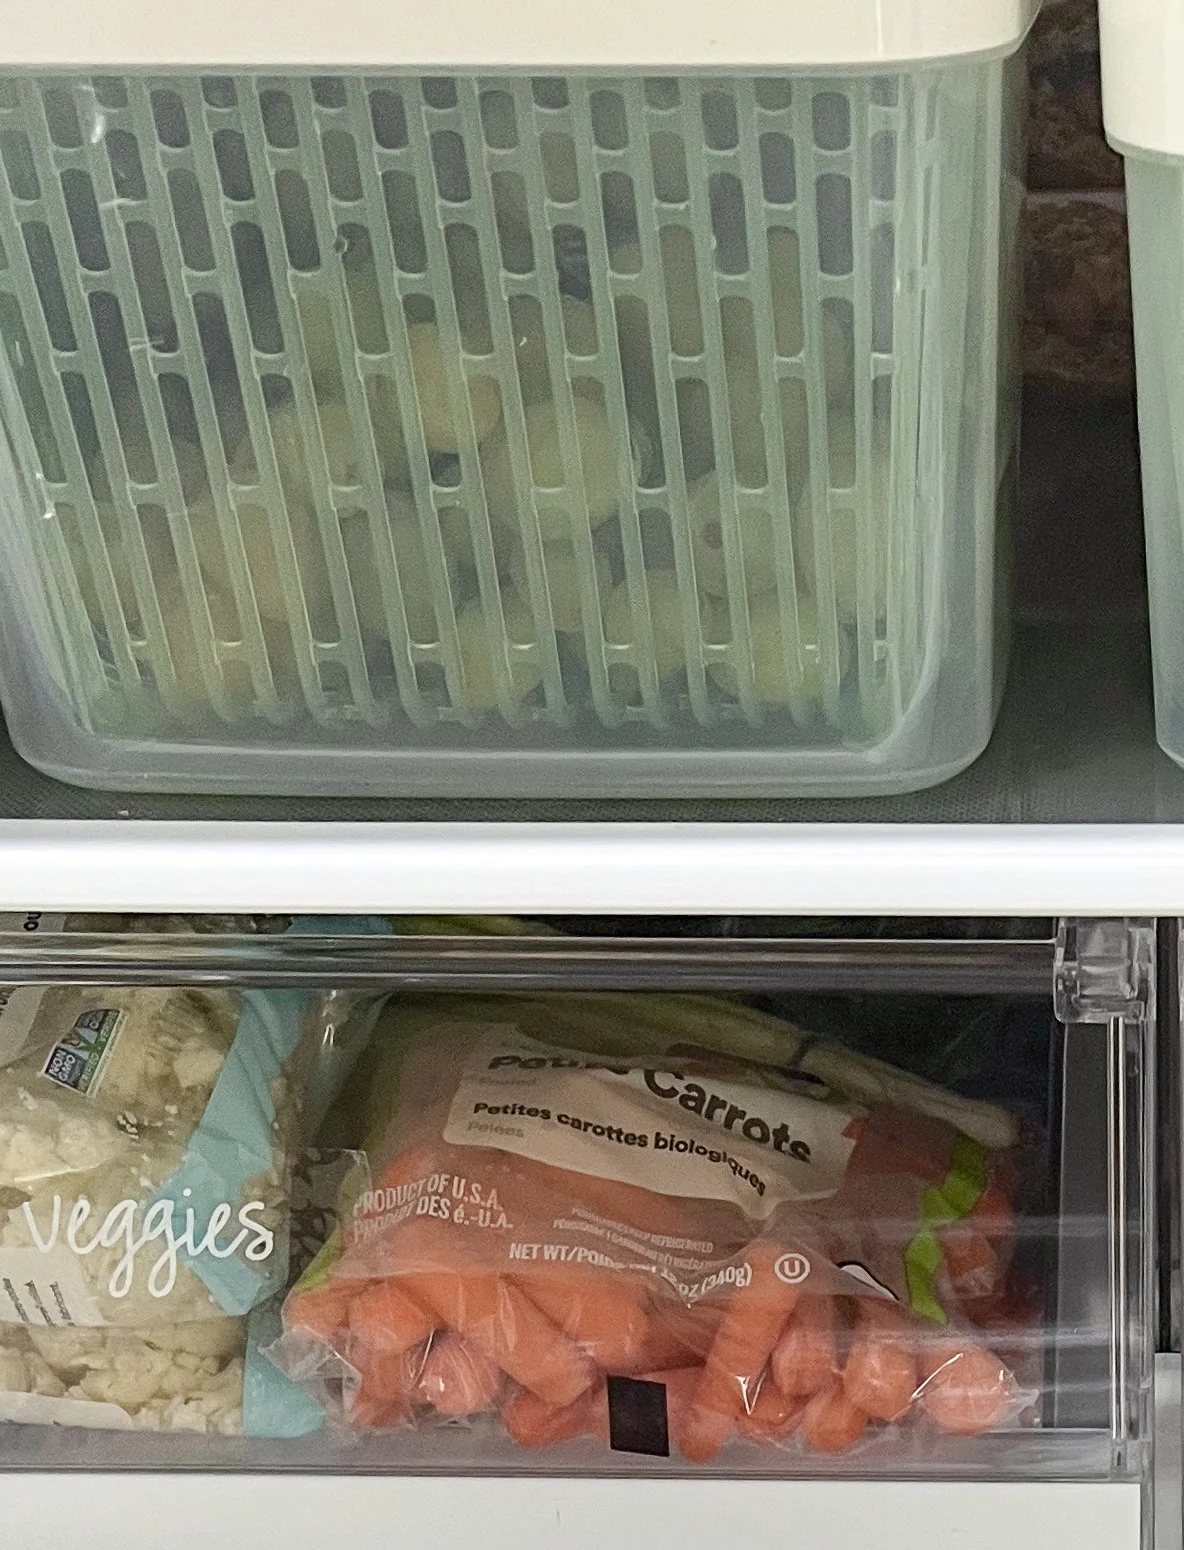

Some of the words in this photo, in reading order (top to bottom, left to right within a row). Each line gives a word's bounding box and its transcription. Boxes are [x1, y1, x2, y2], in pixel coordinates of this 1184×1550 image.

[474, 1102, 551, 1120] Petites
[557, 1112, 648, 1147] carottes
[654, 1133, 765, 1197] biologiques
[644, 1069, 811, 1164] Carrots
[353, 1180, 427, 1218] PRODUCT
[427, 1173, 450, 1193] OF
[451, 1176, 504, 1211] U.S.A.
[416, 1196, 450, 1219] DES
[22, 1187, 274, 1298] veggies
[509, 1242, 540, 1260] NET
